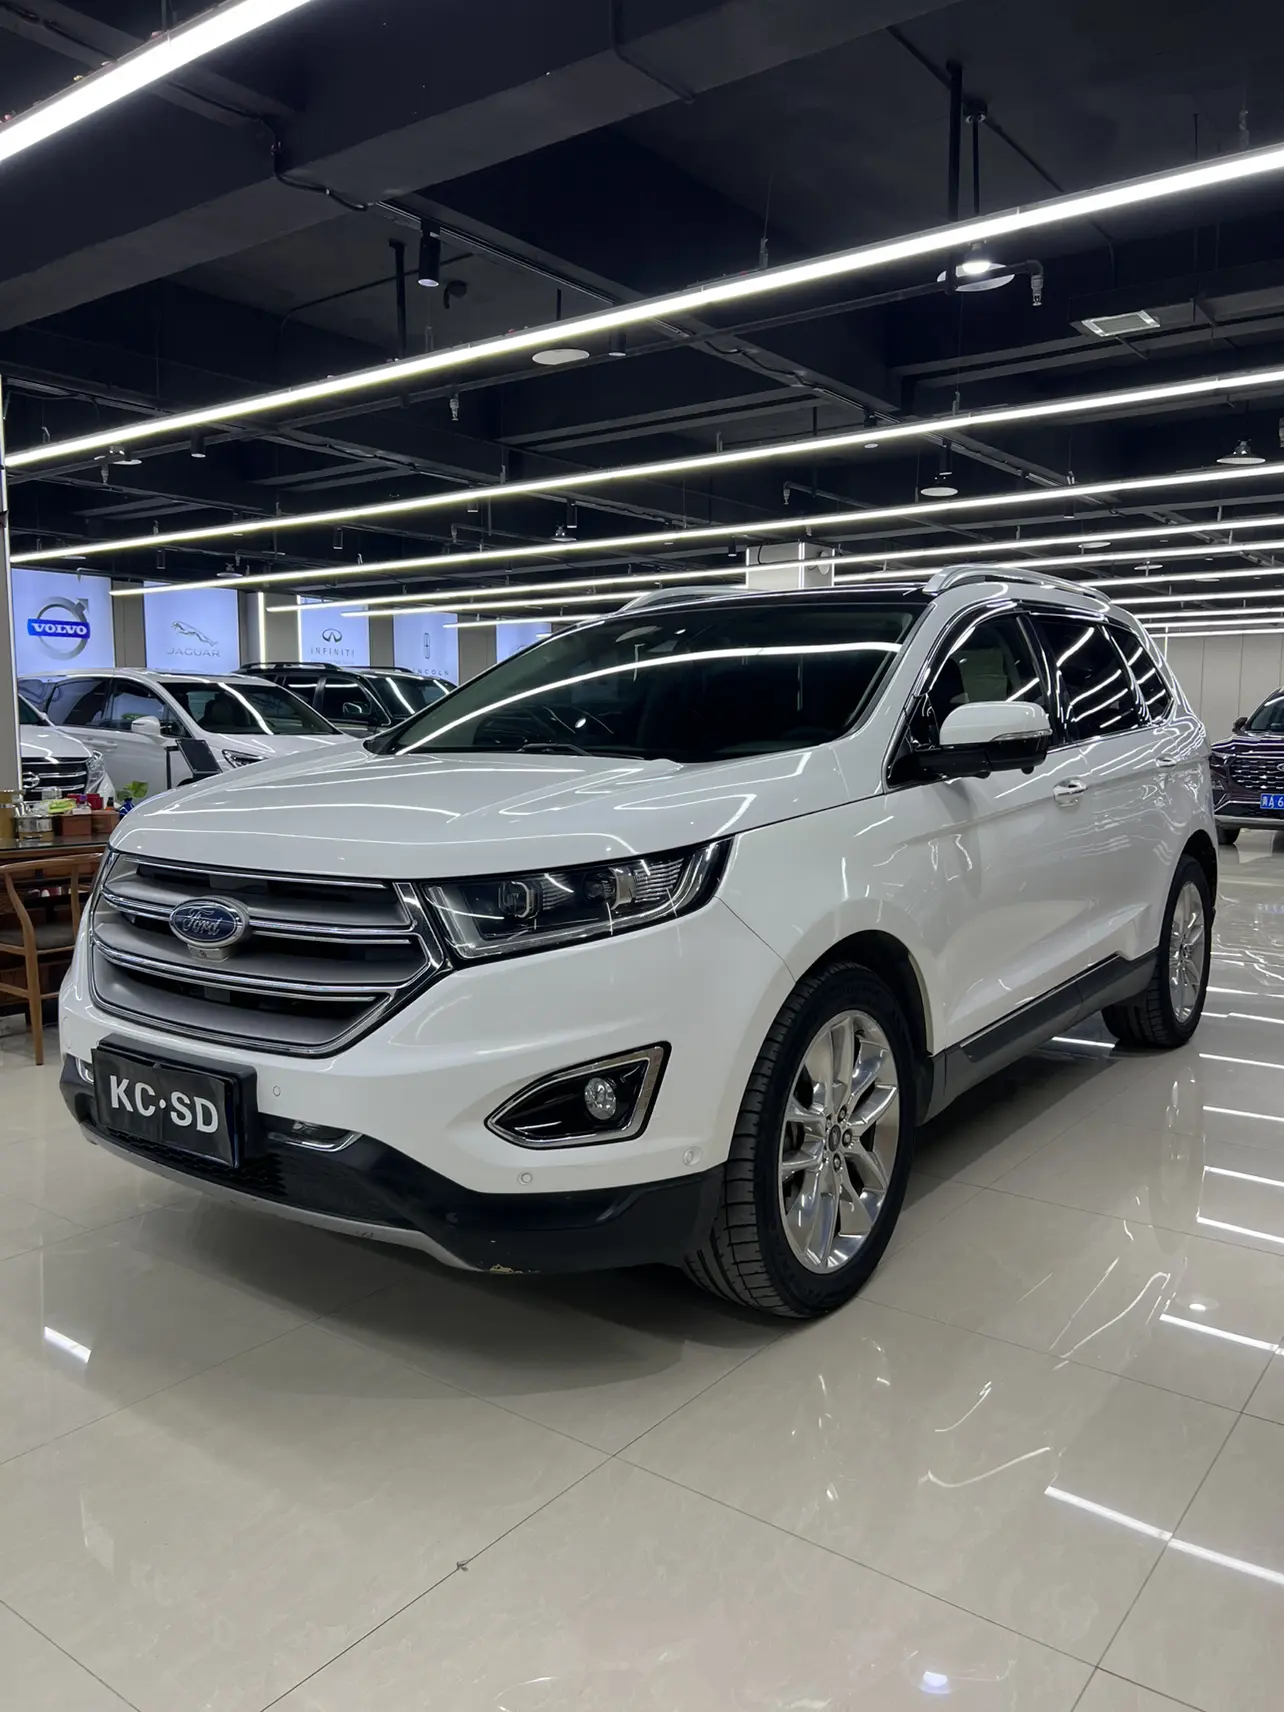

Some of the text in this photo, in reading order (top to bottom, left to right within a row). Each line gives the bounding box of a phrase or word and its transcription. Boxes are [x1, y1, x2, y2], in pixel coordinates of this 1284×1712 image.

[31, 622, 87, 635] VOLVO
[166, 647, 221, 657] JAGUAR
[310, 647, 355, 658] INFINITI
[412, 668, 449, 676] NCOLN
[181, 907, 221, 936] Ford
[109, 1074, 219, 1134] KC·SD
